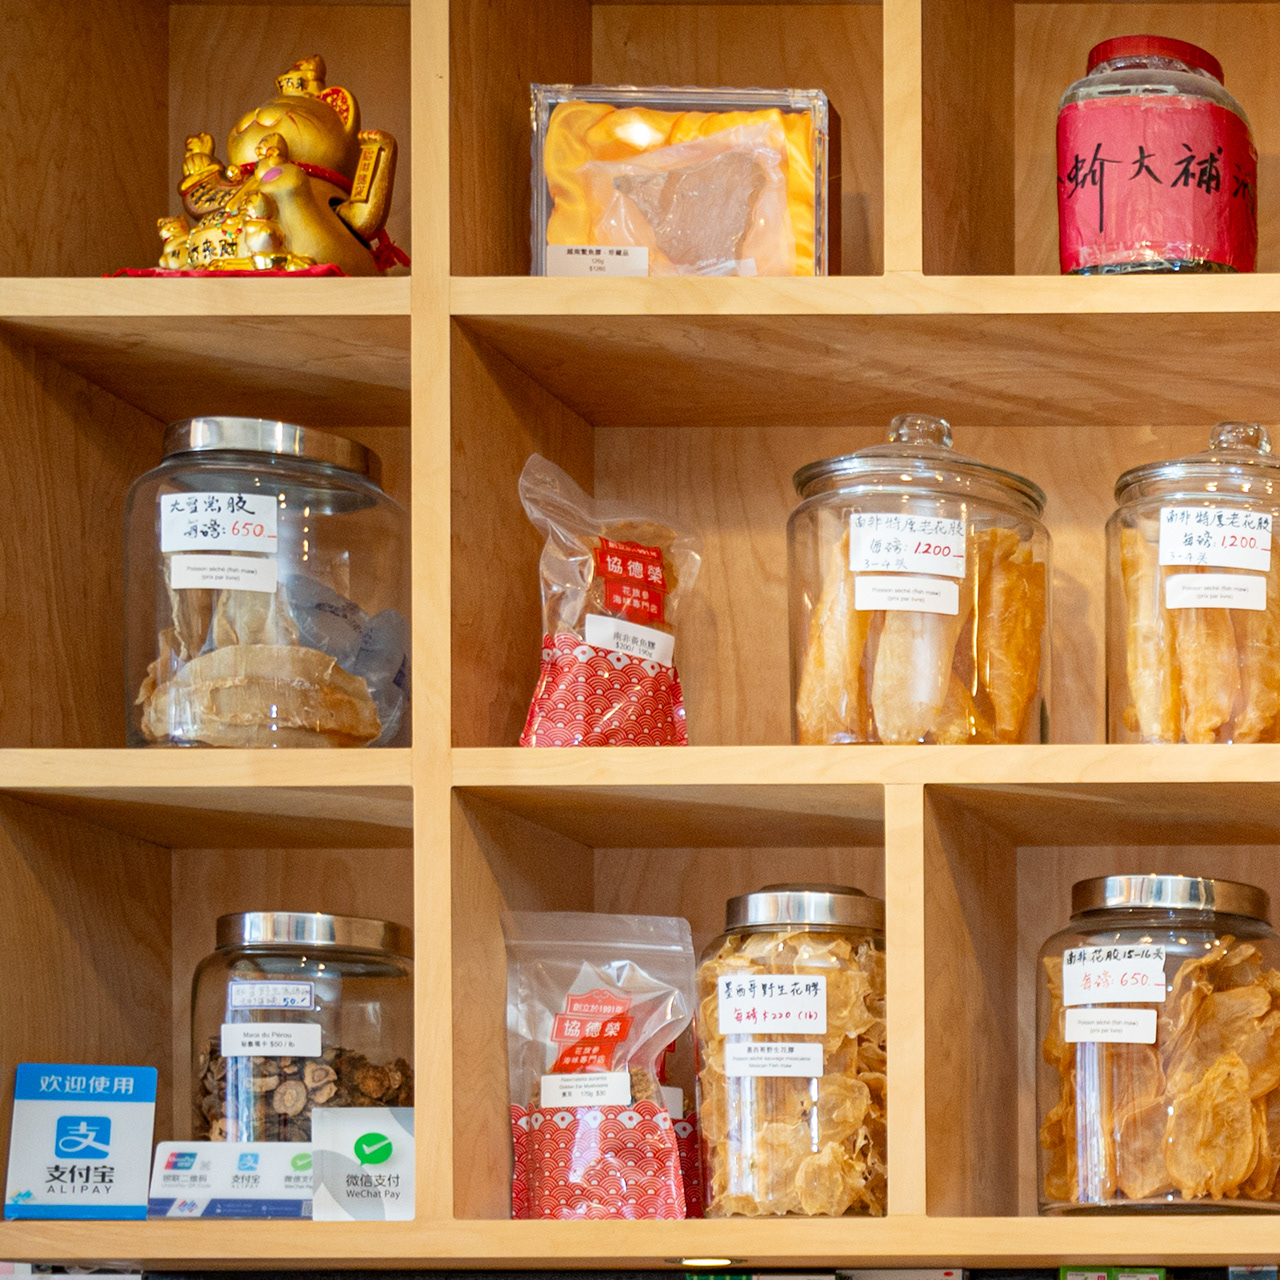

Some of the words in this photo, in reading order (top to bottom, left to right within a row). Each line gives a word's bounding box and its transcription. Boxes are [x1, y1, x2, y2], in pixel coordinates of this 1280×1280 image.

[606, 555, 662, 583] 協德榮
[563, 1021, 620, 1038] 協德榮
[39, 1076, 134, 1095] 欢迎使用
[45, 1165, 115, 1184] 支付宝
[346, 1173, 400, 1188] 微信支付
[46, 1185, 112, 1194] ALIPAY
[384, 1189, 401, 1200] Pay
